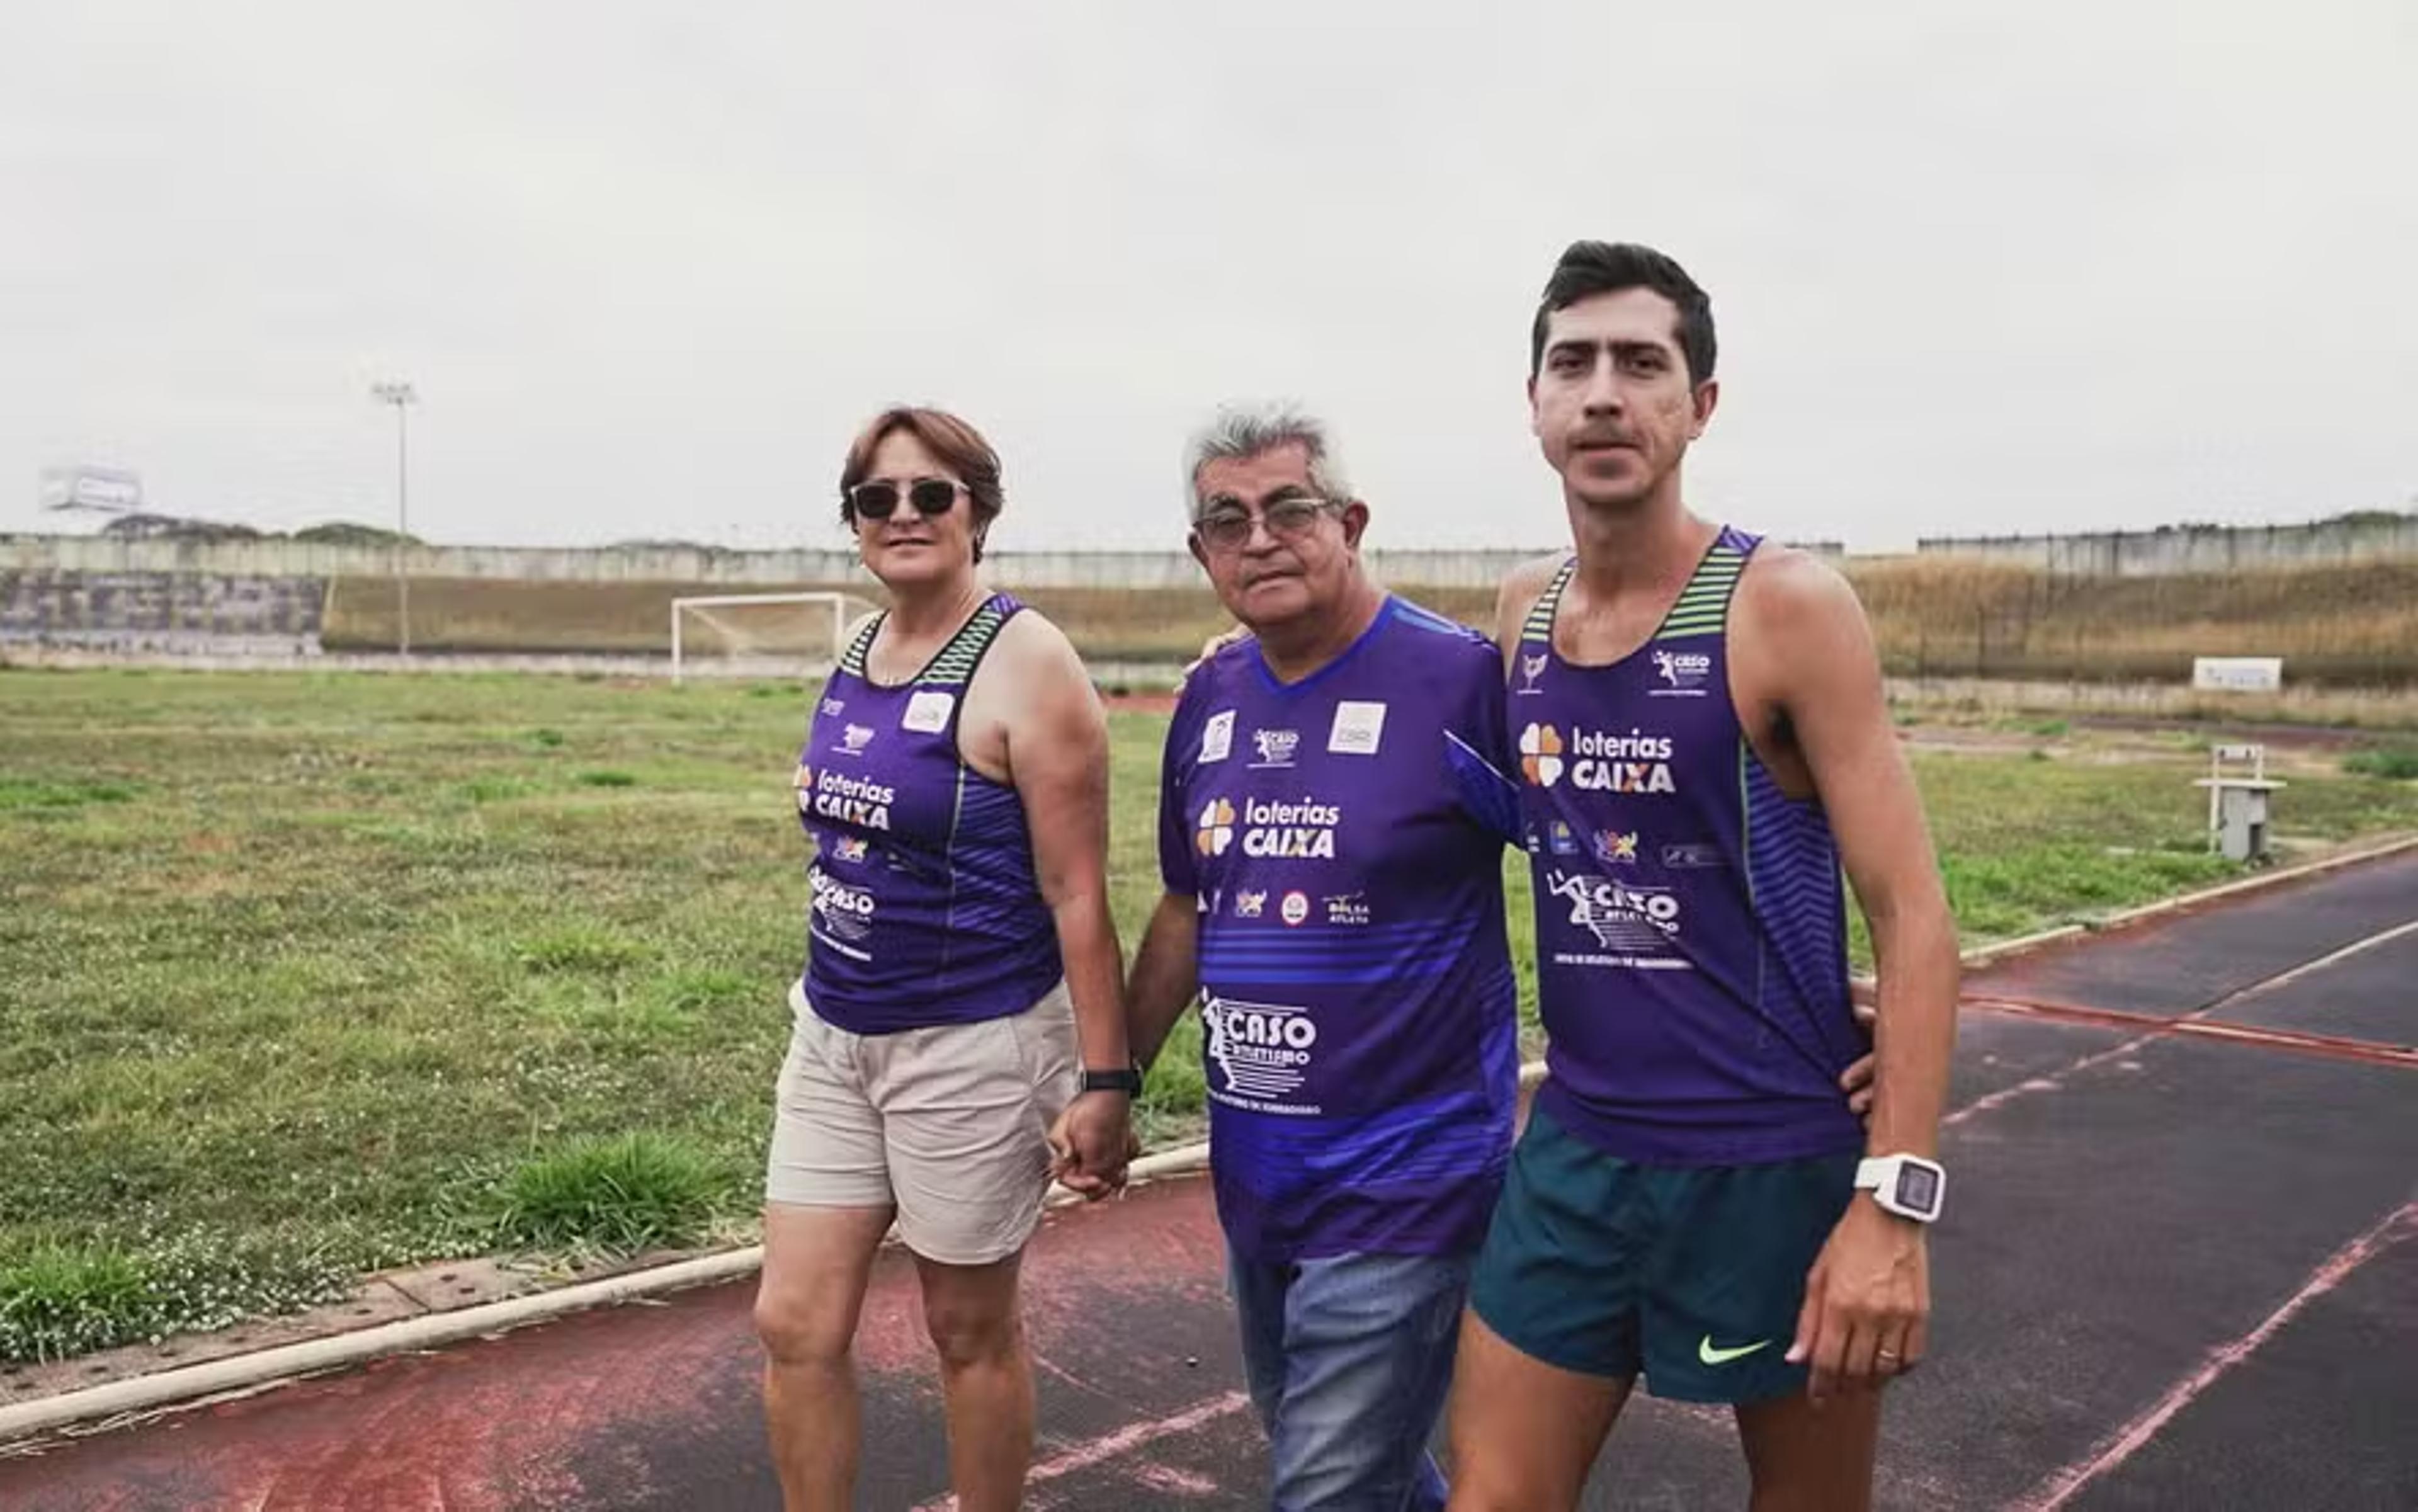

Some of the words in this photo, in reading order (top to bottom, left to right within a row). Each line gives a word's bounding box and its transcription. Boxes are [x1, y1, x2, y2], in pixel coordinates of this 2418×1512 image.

[1573, 727, 1672, 759] loterias
[818, 769, 895, 805] loterias
[1572, 759, 1676, 793] CAIXA
[815, 793, 890, 831] CAIXA
[1245, 796, 1341, 826] loterias
[1243, 827, 1334, 858] CAIXA
[1228, 1009, 1317, 1050] CASO
